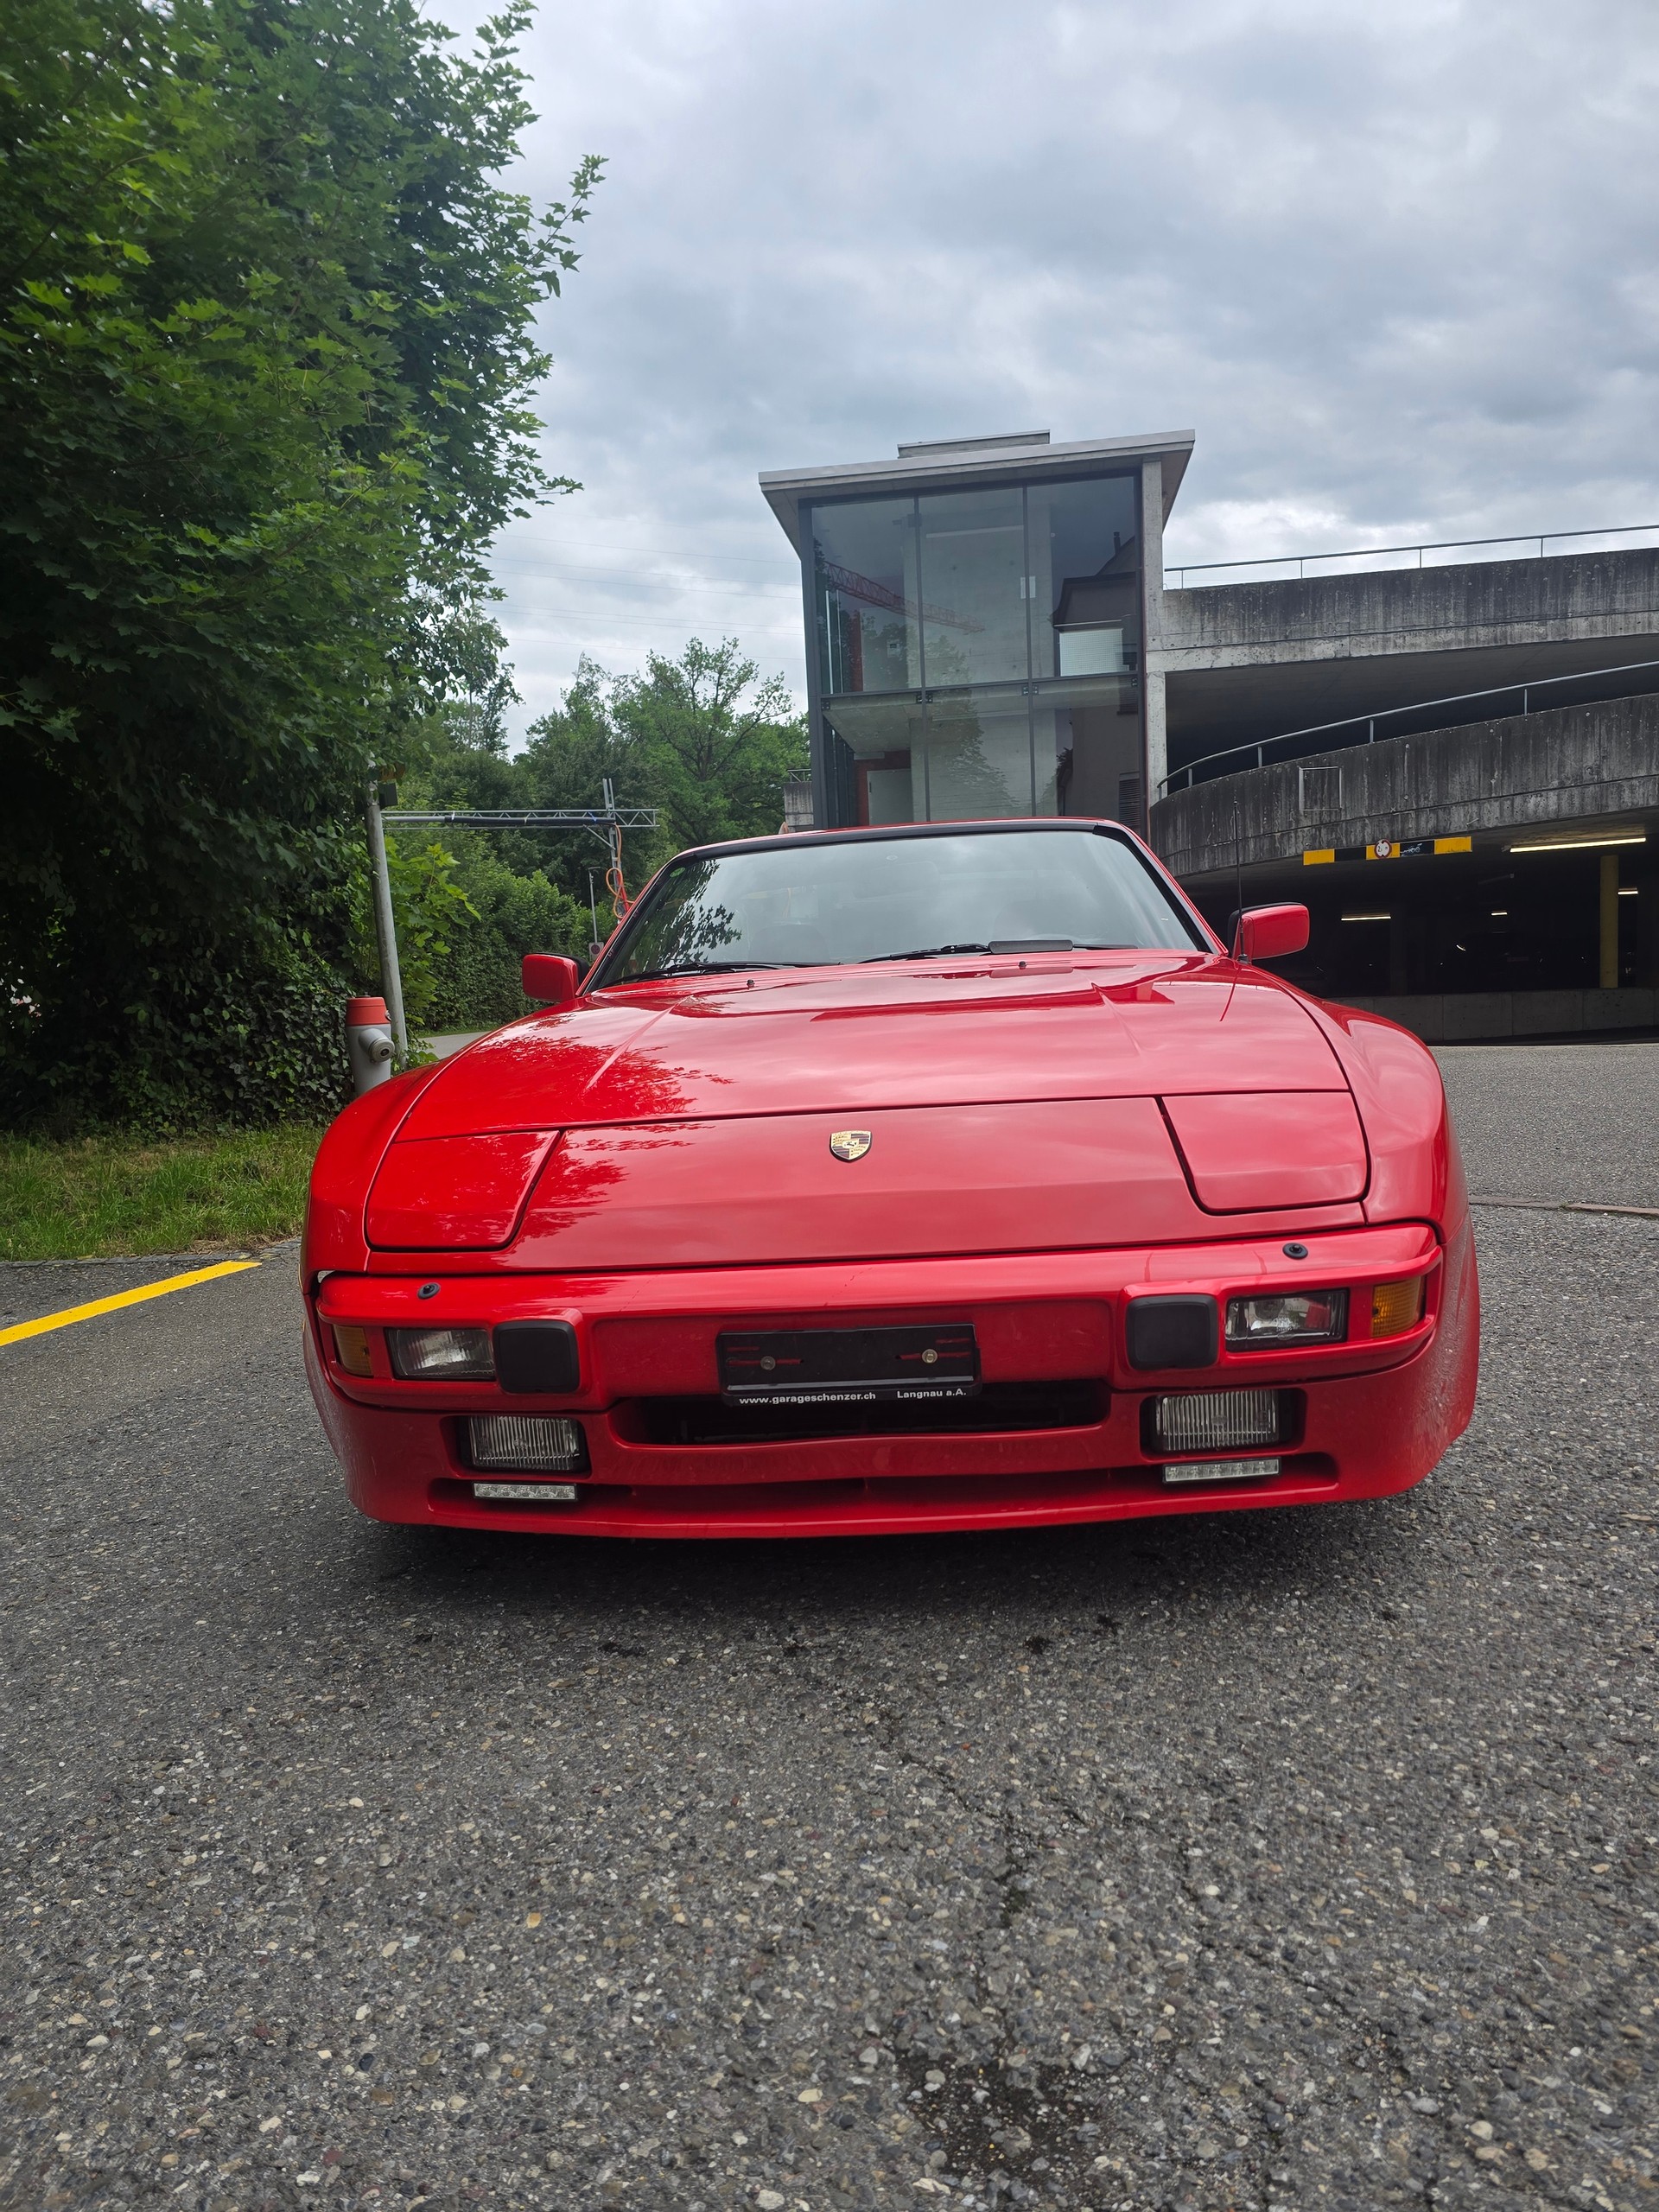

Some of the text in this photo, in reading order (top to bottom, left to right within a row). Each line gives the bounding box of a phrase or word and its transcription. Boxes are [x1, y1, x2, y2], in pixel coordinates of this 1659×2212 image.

[739, 1388, 967, 1405] www.garageschenzer.ch Langnau a.A.
